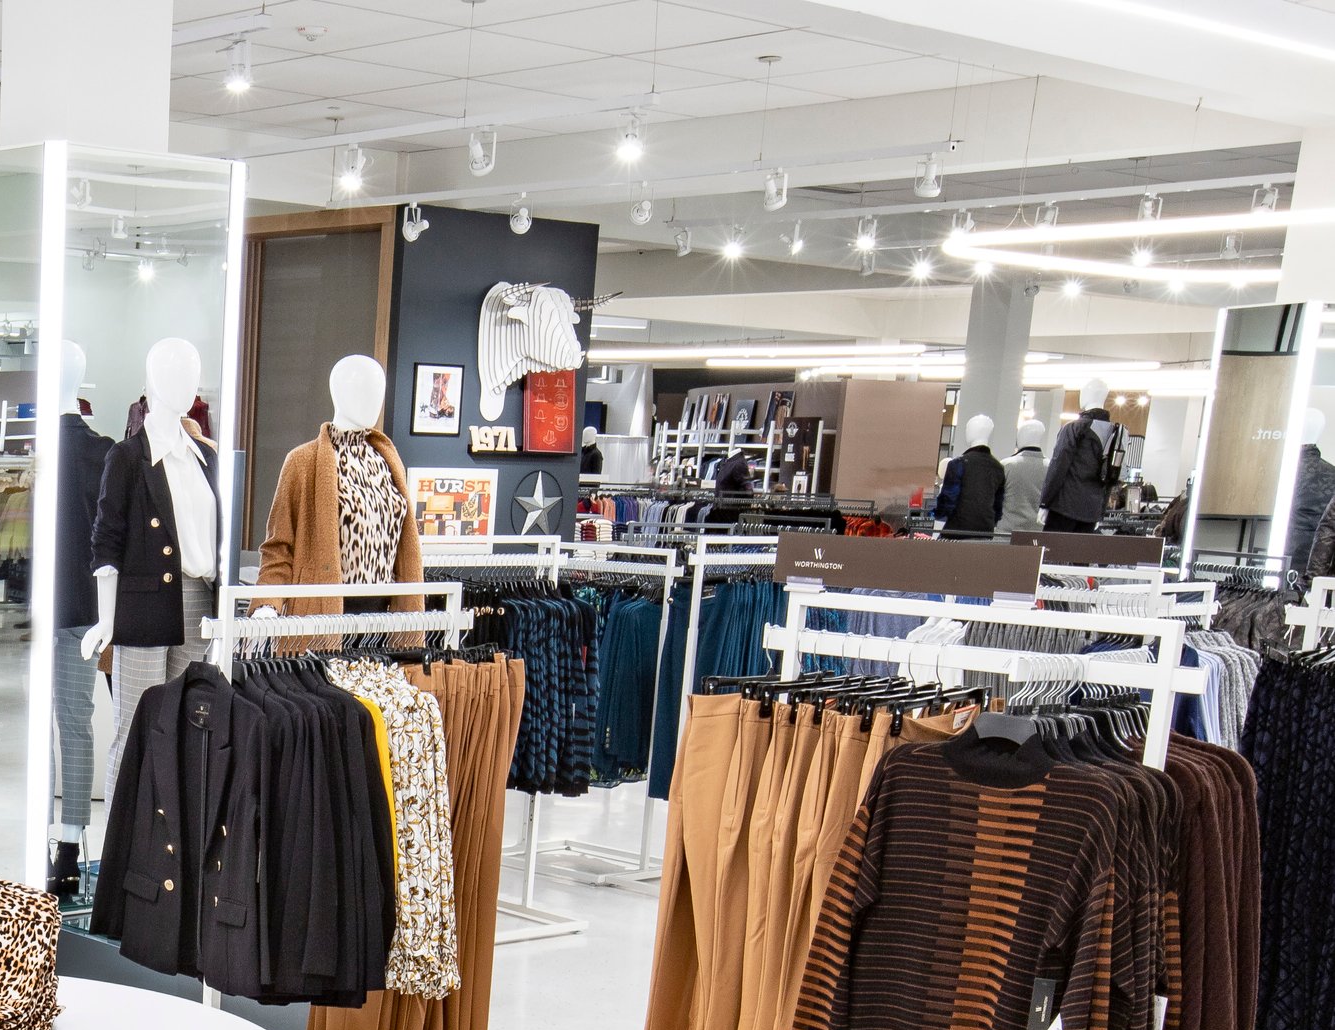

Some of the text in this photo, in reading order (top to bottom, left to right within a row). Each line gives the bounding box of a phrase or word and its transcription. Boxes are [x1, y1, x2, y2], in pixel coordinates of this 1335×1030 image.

[468, 425, 518, 453] 1971
[418, 479, 491, 493] HURST
[794, 560, 844, 570] WORTHINGTON
